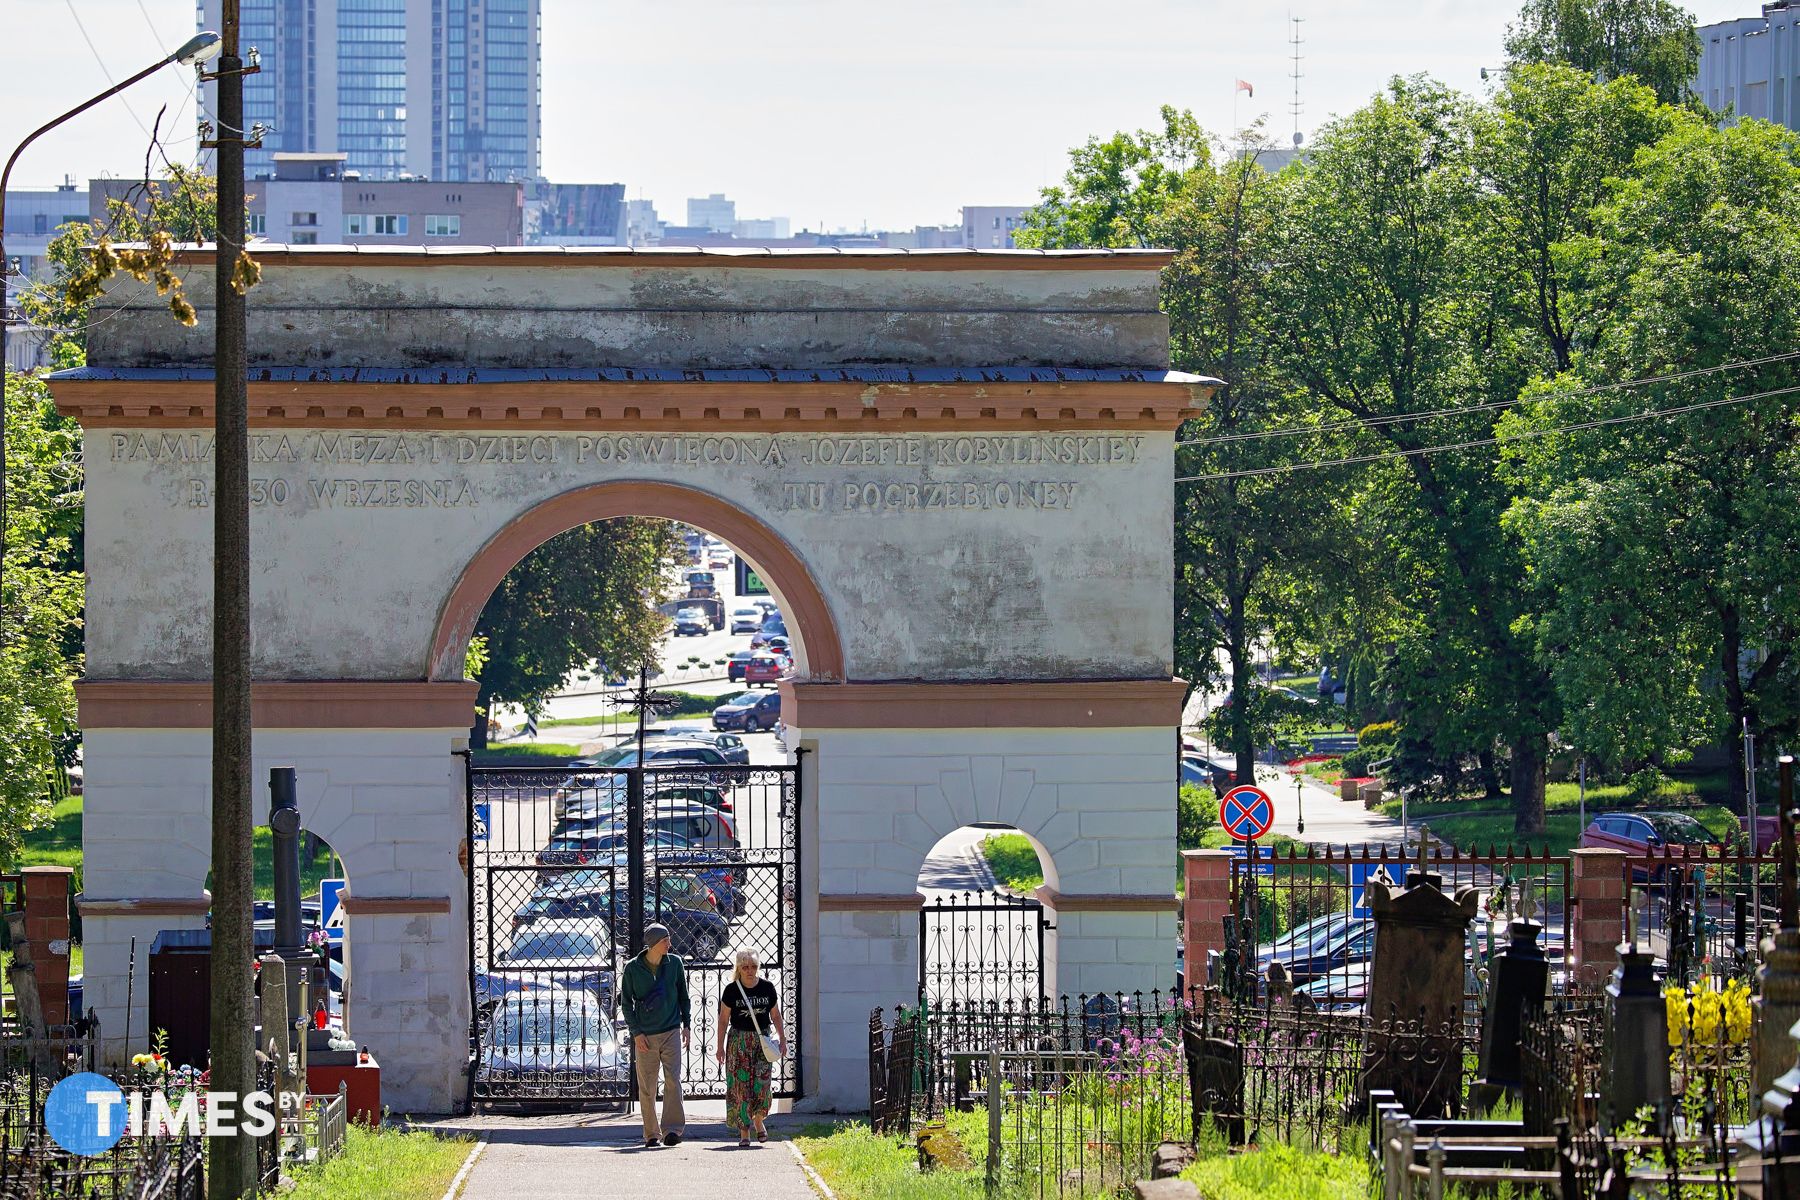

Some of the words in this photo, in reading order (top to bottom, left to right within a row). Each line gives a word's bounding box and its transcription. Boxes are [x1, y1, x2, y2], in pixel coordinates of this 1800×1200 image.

[110, 432, 297, 463] PAMIAKA
[430, 435, 441, 464] I
[456, 435, 559, 464] DZIECI
[801, 437, 921, 465] JOZEFIE
[936, 436, 1145, 465] KOBYLINSKIEY
[308, 478, 479, 509] WRZESNIA
[784, 481, 825, 511] TU
